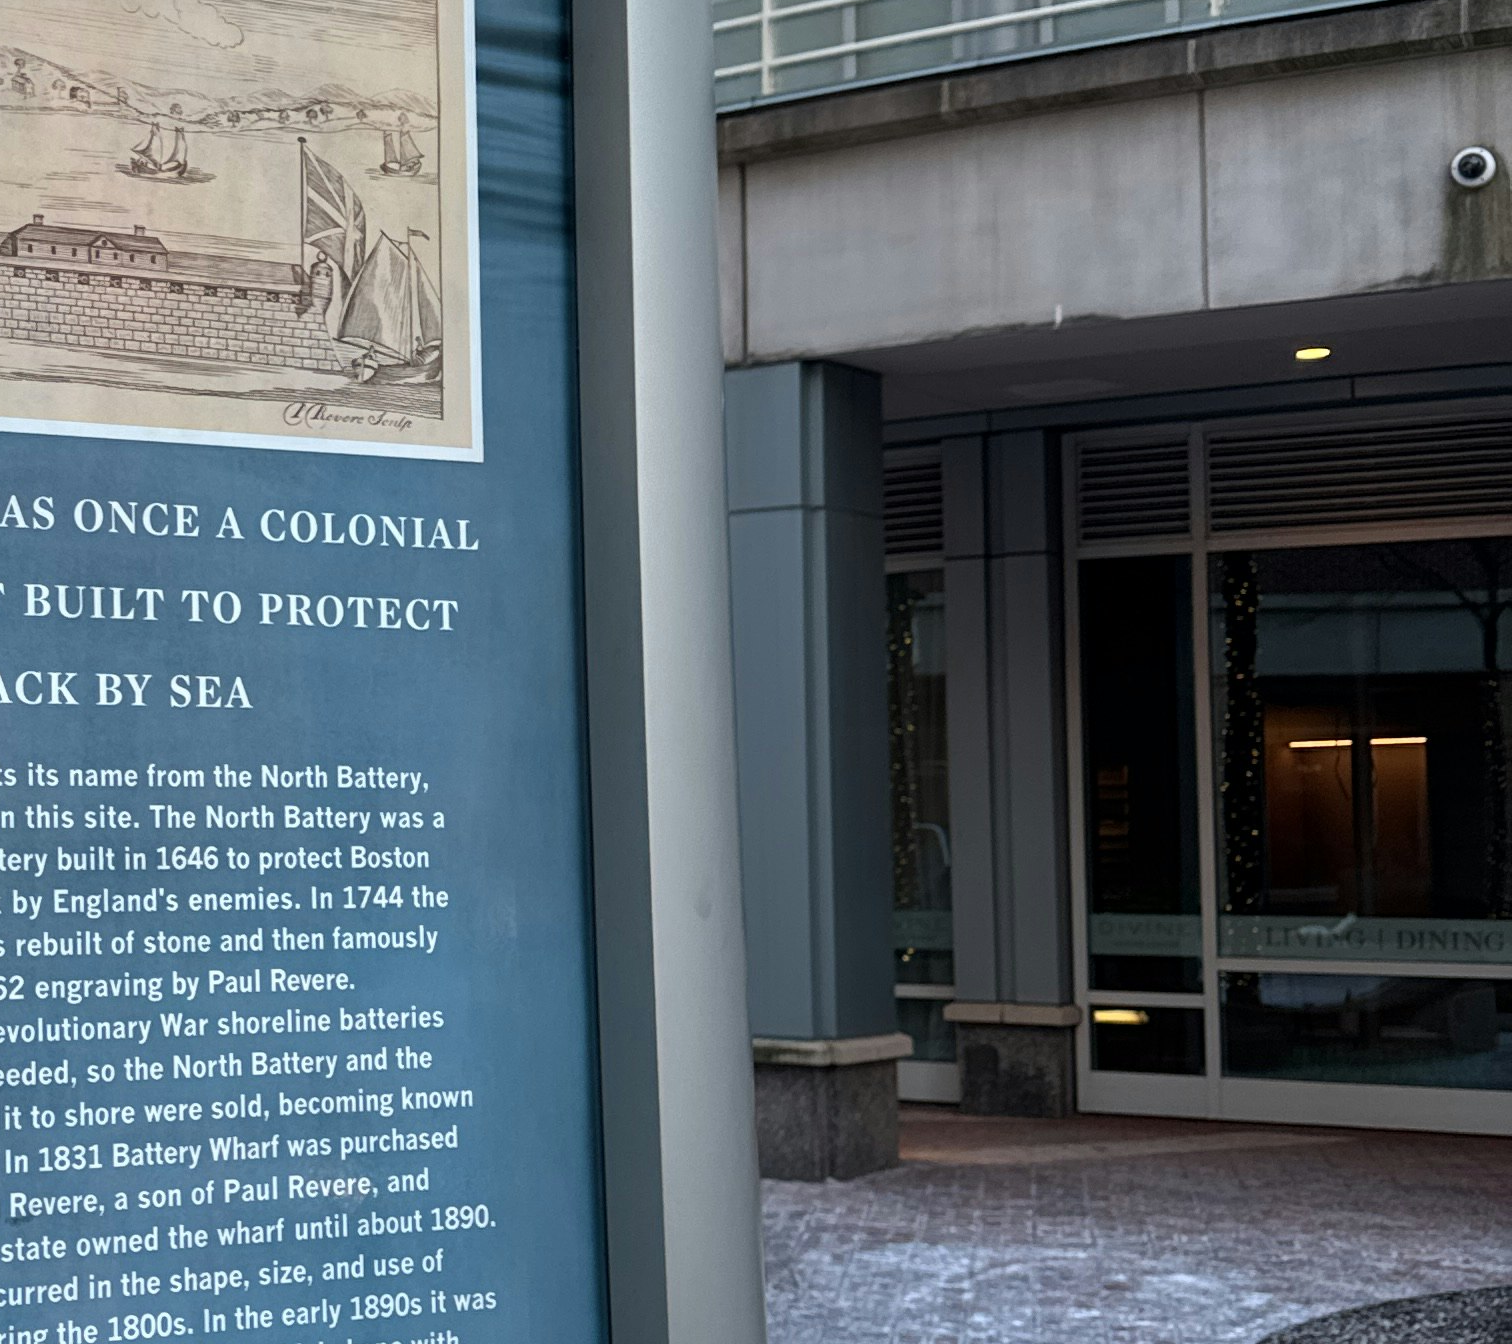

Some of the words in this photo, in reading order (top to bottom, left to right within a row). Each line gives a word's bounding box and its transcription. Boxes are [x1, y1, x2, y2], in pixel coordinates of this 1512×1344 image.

[73, 500, 199, 538] ONCE
[216, 510, 244, 542] A
[259, 508, 480, 550] COLONIAL
[24, 584, 164, 620] BUILT
[181, 590, 241, 624] TO
[258, 593, 458, 630] PROTECT
[95, 673, 152, 706] BY
[170, 674, 253, 708] SEA
[27, 761, 60, 787] its
[68, 768, 139, 788] name
[146, 762, 205, 788] from
[212, 763, 253, 789] the
[260, 764, 329, 789] North
[336, 764, 429, 796] Battery,
[23, 803, 75, 830] this
[83, 803, 140, 830] site.
[148, 804, 197, 829] The
[205, 804, 275, 829] North
[283, 804, 372, 835] Battery
[379, 811, 425, 829] was
[432, 811, 445, 829] a
[56, 845, 116, 872] built
[123, 845, 147, 871] in
[155, 845, 220, 871] 1646
[225, 846, 251, 870] to
[258, 846, 344, 876] protect
[349, 845, 430, 869] Boston
[11, 888, 43, 921] by
[53, 887, 179, 920] England's
[187, 885, 301, 912] enemies.
[310, 885, 334, 910] In
[342, 884, 405, 910] 1744
[410, 884, 449, 909] the
[15, 930, 103, 957] rebuilt
[110, 929, 136, 955] of
[143, 930, 212, 955] stone
[219, 927, 264, 953] and
[271, 926, 325, 952] then
[331, 924, 439, 955] famously
[1396, 928, 1505, 952] DINING
[34, 971, 164, 1005] engraving
[171, 970, 200, 1001] by
[208, 968, 261, 995] Paul
[269, 968, 356, 993] Revere.
